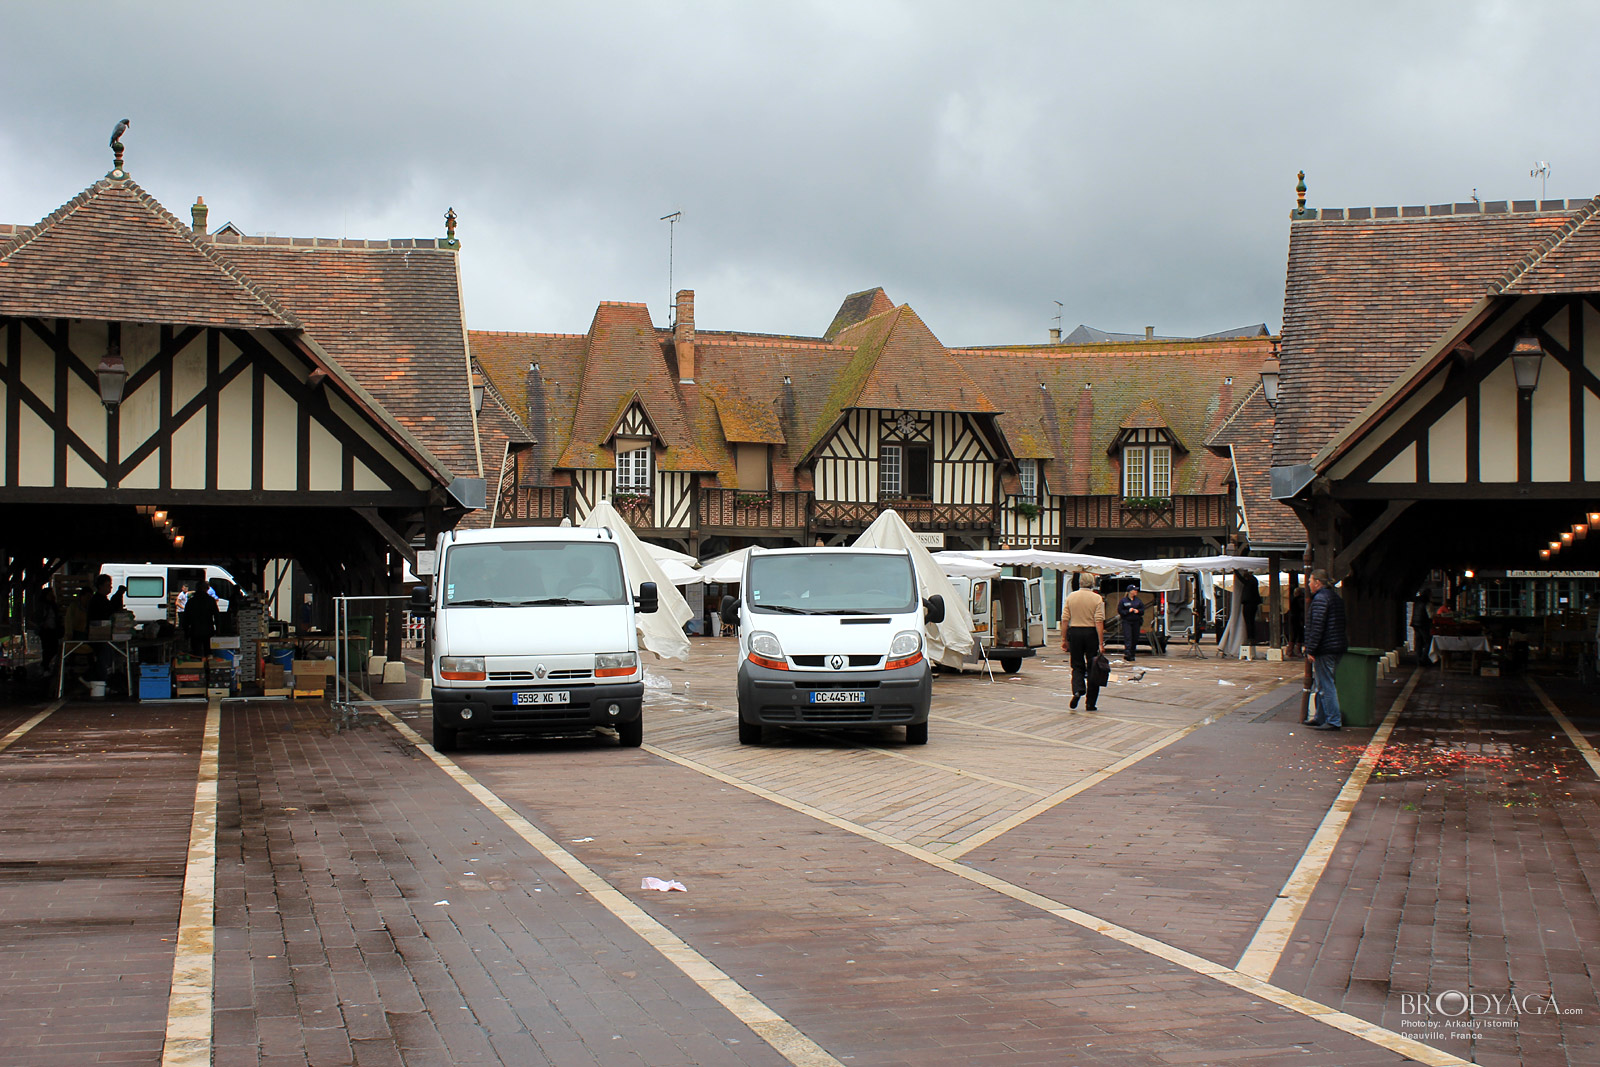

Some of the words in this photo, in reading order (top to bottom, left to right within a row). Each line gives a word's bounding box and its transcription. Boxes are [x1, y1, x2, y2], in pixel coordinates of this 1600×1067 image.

[518, 693, 539, 703] 5592
[543, 693, 554, 702] XG
[559, 692, 567, 702] 14
